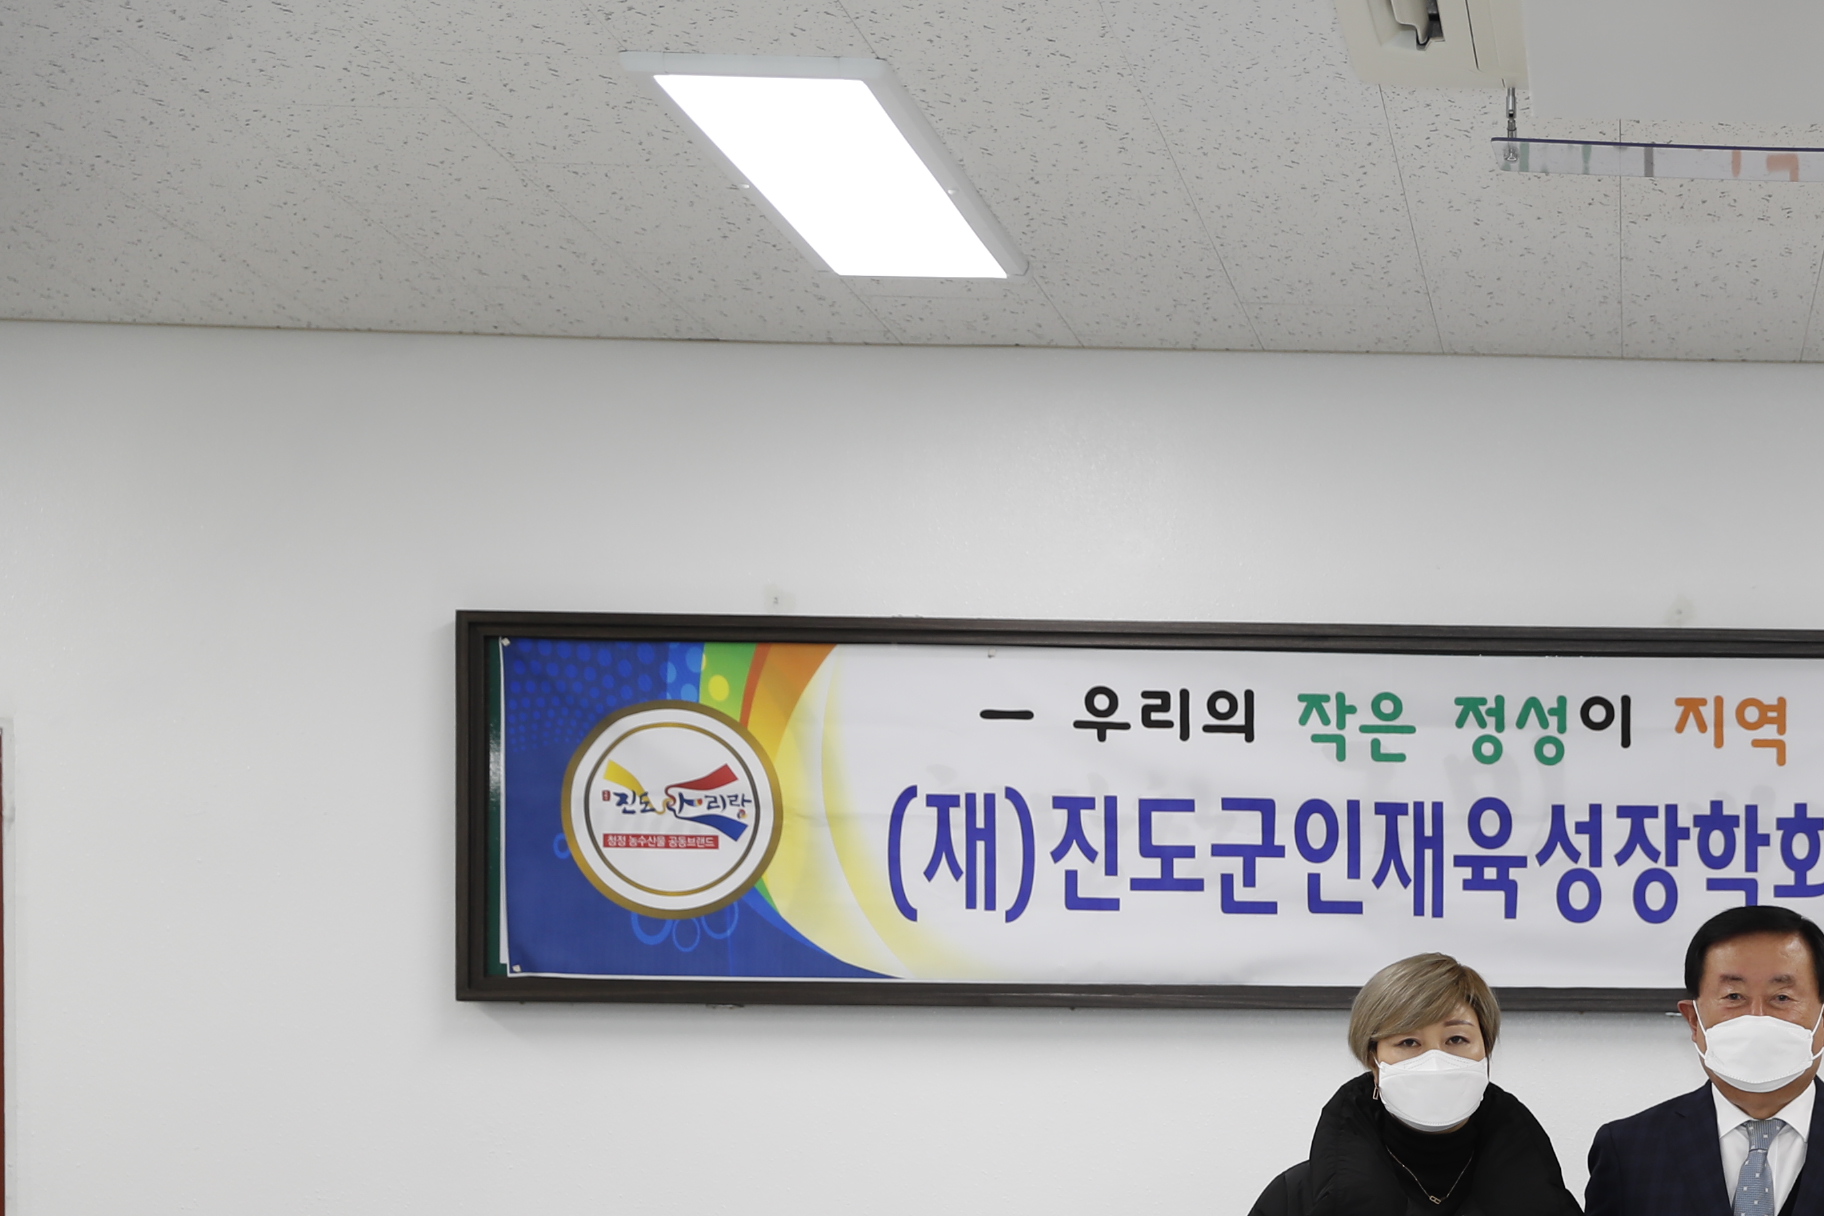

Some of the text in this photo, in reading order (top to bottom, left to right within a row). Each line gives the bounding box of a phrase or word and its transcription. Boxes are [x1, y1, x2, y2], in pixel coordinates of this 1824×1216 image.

[1073, 686, 1256, 745] 우리의
[1298, 692, 1418, 764] 작은
[1455, 692, 1633, 767] 정성이
[1675, 696, 1788, 768] 지역
[668, 837, 715, 848] 공동브랜드
